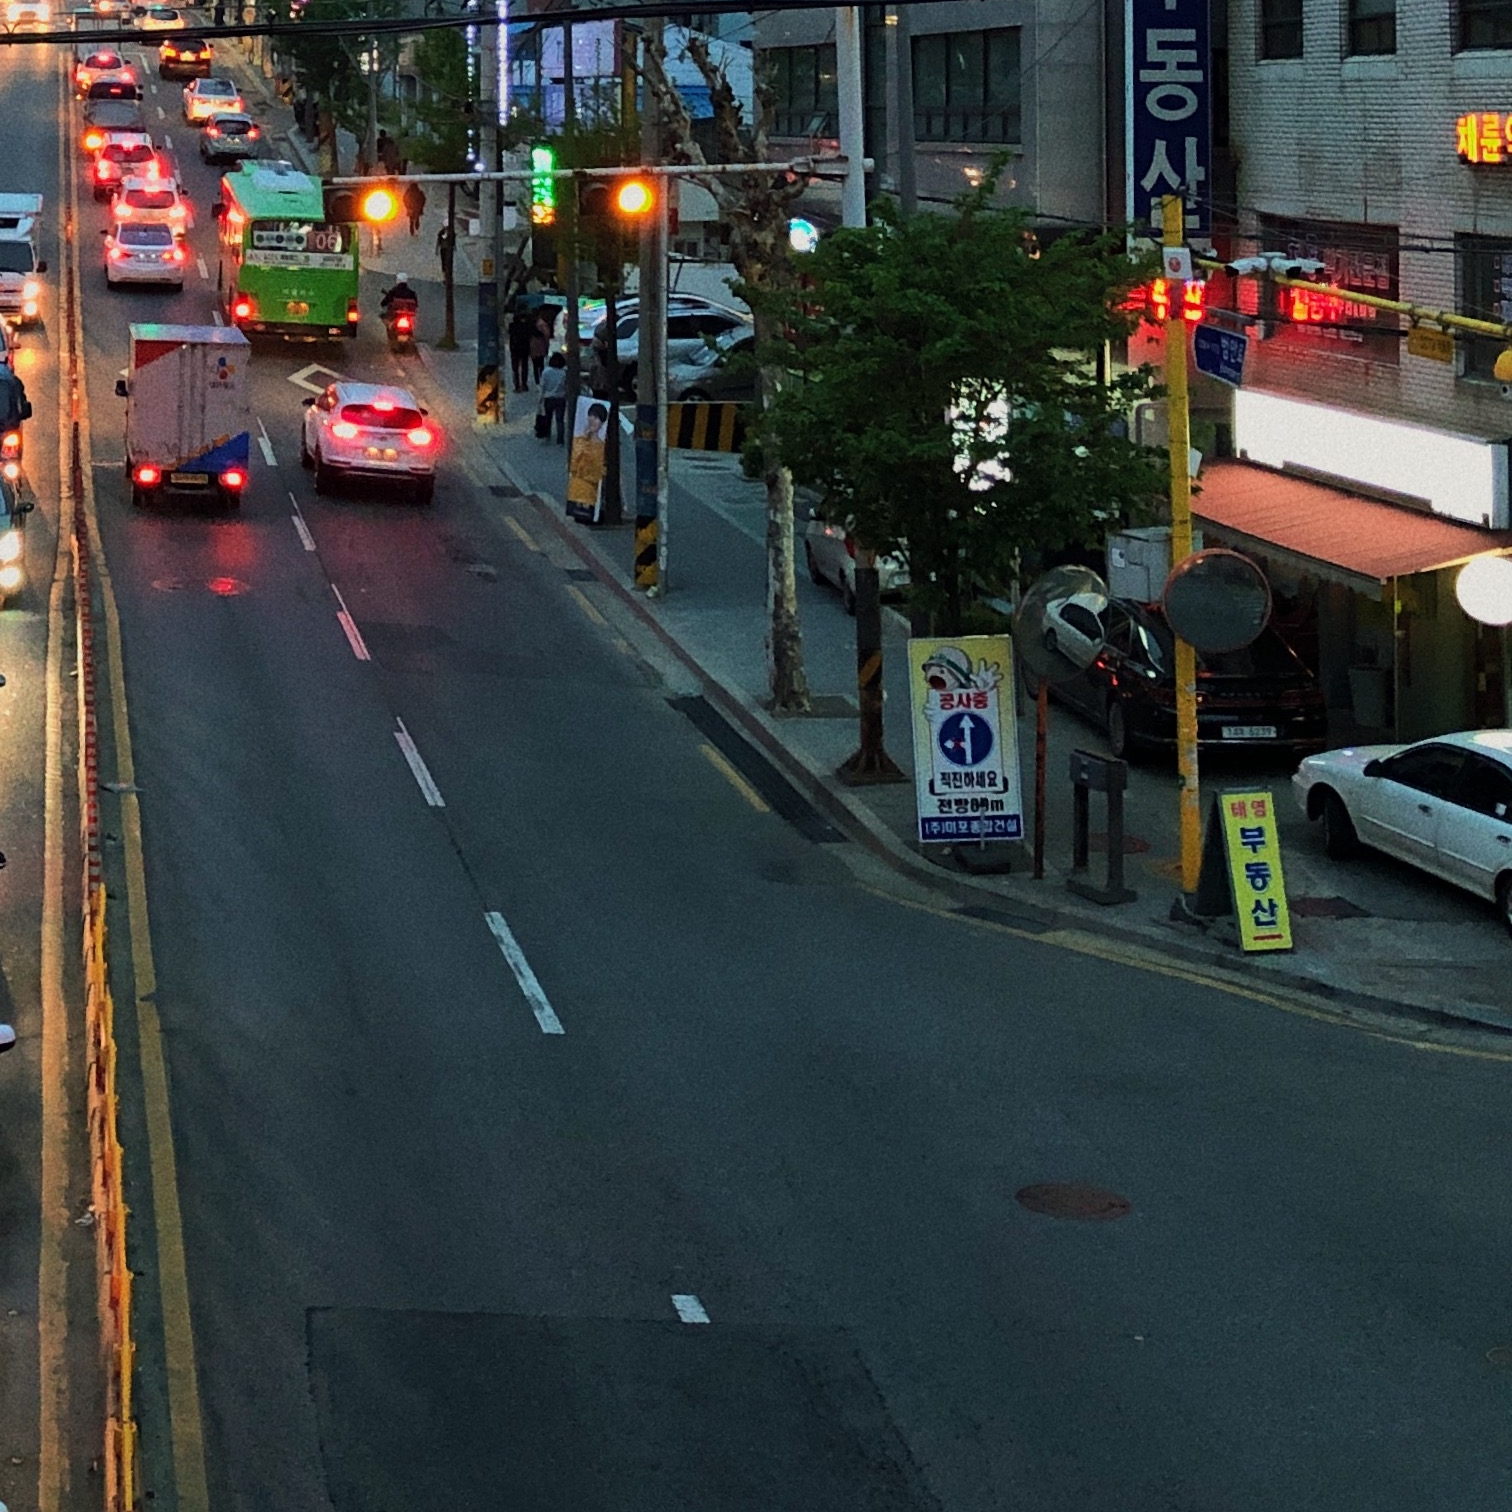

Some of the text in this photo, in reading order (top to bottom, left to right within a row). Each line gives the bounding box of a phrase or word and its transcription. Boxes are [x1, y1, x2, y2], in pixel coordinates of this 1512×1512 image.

[939, 690, 989, 711] 공사중
[940, 771, 999, 790] 직진하세요
[1230, 800, 1267, 819] 태영
[1239, 825, 1279, 928] 부동산
